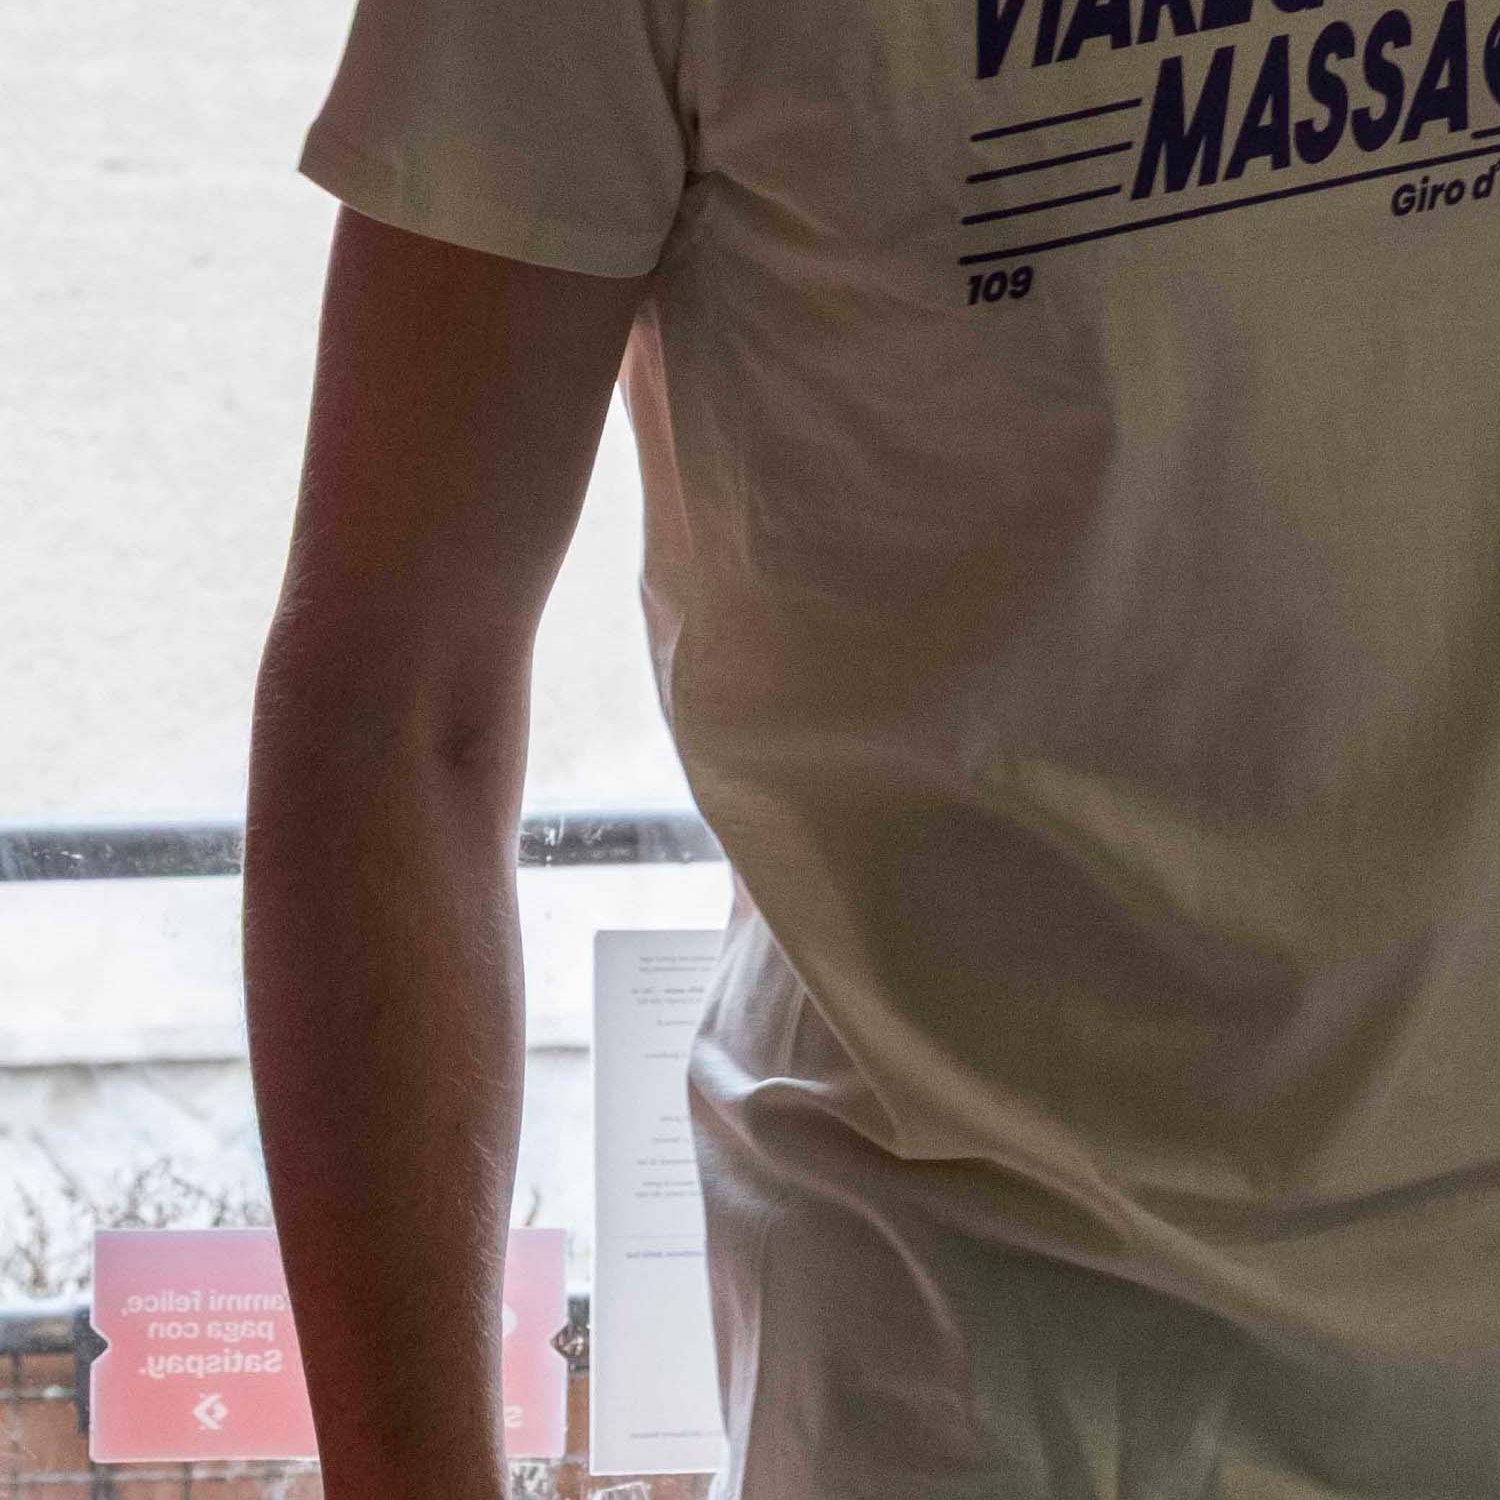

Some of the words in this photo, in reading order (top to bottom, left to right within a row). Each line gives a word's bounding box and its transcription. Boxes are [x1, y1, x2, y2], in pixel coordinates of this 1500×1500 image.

[1130, 0, 1469, 201] MASSA
[1390, 163, 1465, 218] Giro
[966, 265, 1034, 306] 109
